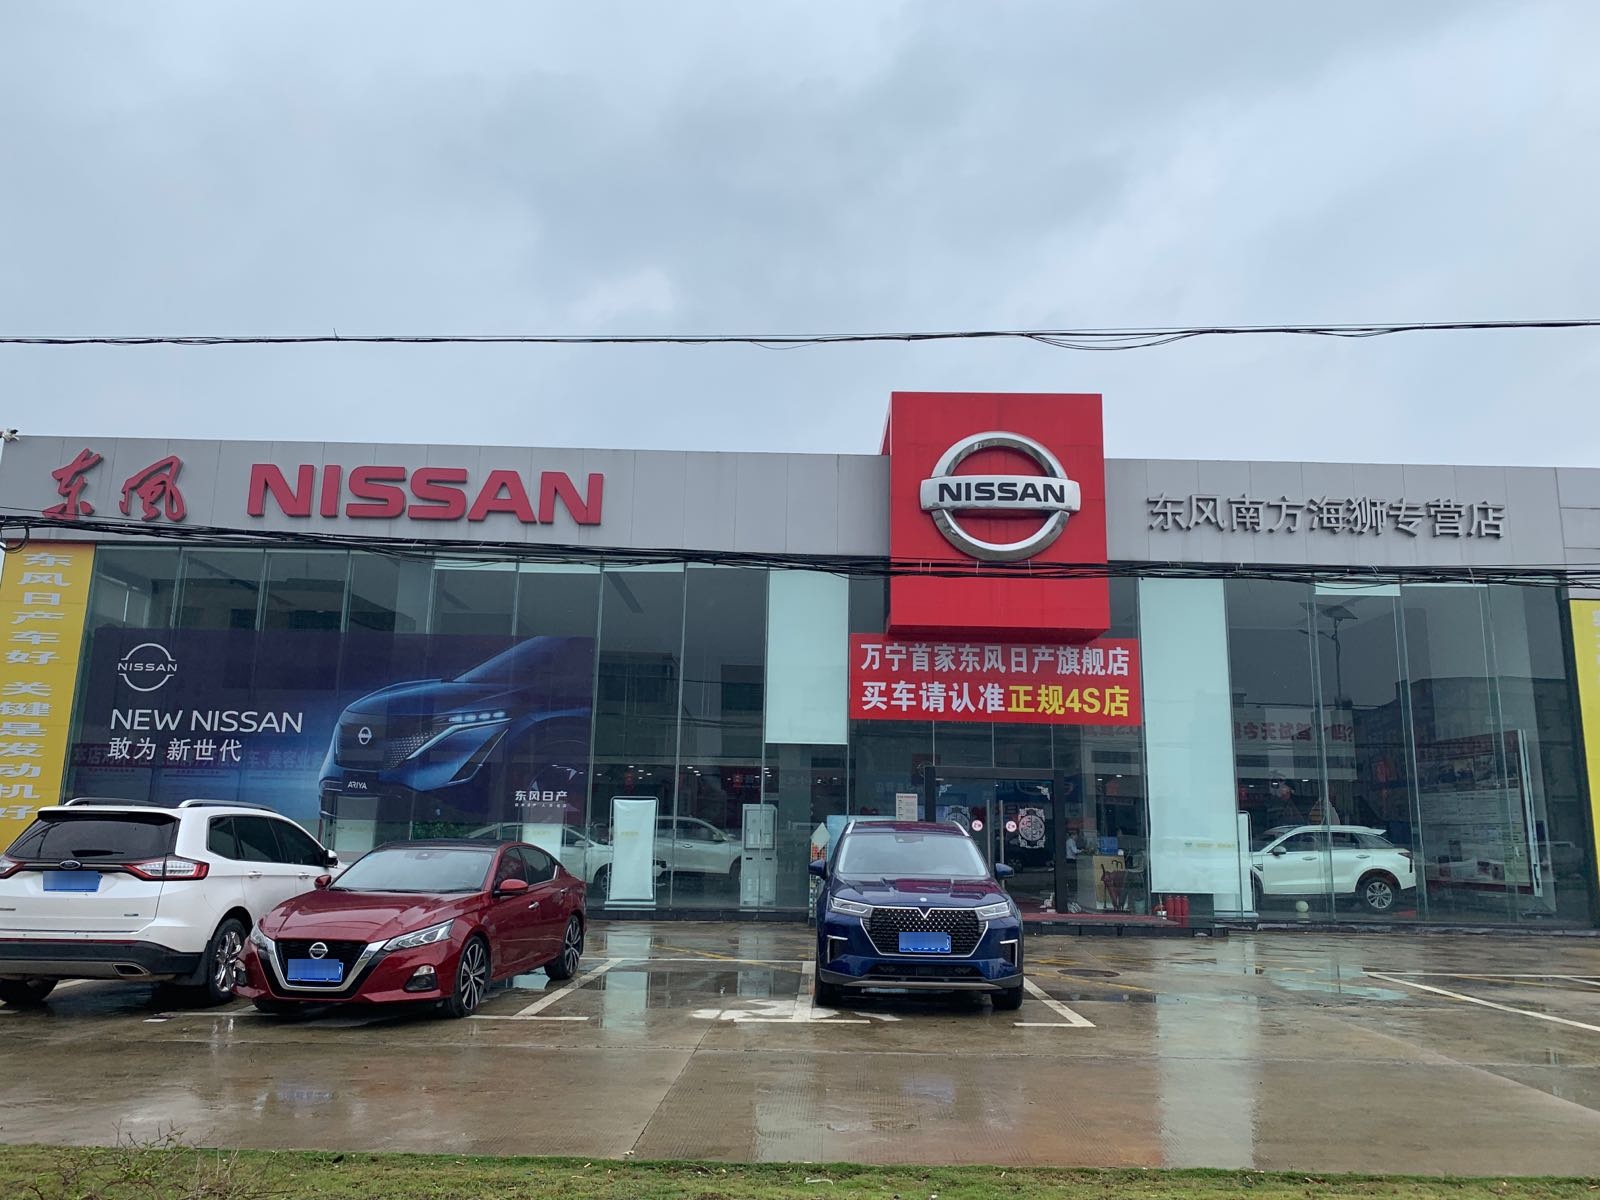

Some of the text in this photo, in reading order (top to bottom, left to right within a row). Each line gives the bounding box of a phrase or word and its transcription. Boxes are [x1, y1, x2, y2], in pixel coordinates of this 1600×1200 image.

[247, 463, 605, 526] NISSAN
[938, 482, 1065, 503] NISSAN
[1147, 492, 1506, 539] 东风南方海狮专营店
[117, 662, 178, 673] NISSAN
[860, 643, 1130, 677] 万宁首家东风日产旗舰店
[0, 552, 74, 820] 东风日产车好 关键是发动机好
[861, 681, 1130, 717] 买车请认准正规4S店
[109, 709, 303, 734] NEW NISSAN
[107, 737, 156, 761] 敢为
[167, 738, 242, 762] 新世代
[347, 781, 367, 790] ARIYA
[515, 790, 568, 802] 东风日产
